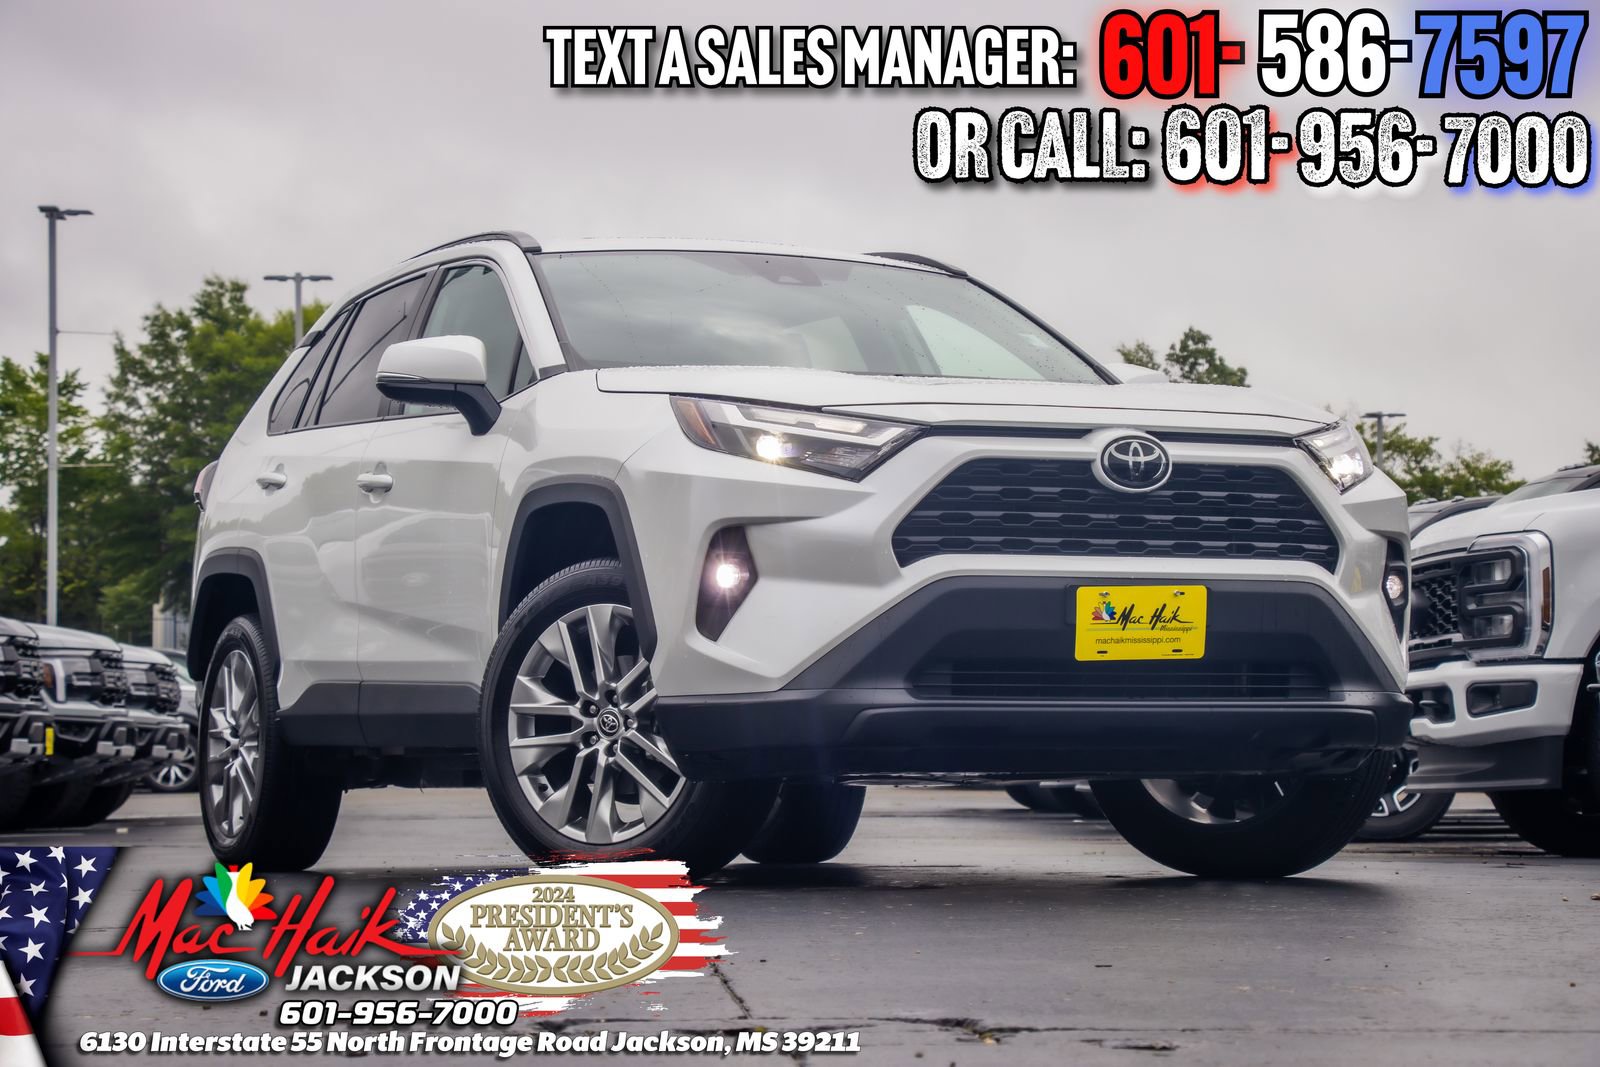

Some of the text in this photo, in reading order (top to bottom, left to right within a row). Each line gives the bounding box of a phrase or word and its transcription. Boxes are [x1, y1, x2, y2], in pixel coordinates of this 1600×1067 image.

[1115, 603, 1187, 631] Mac Haik
[1159, 624, 1193, 633] Mississippi
[1095, 636, 1182, 645] machaikmississippi.com
